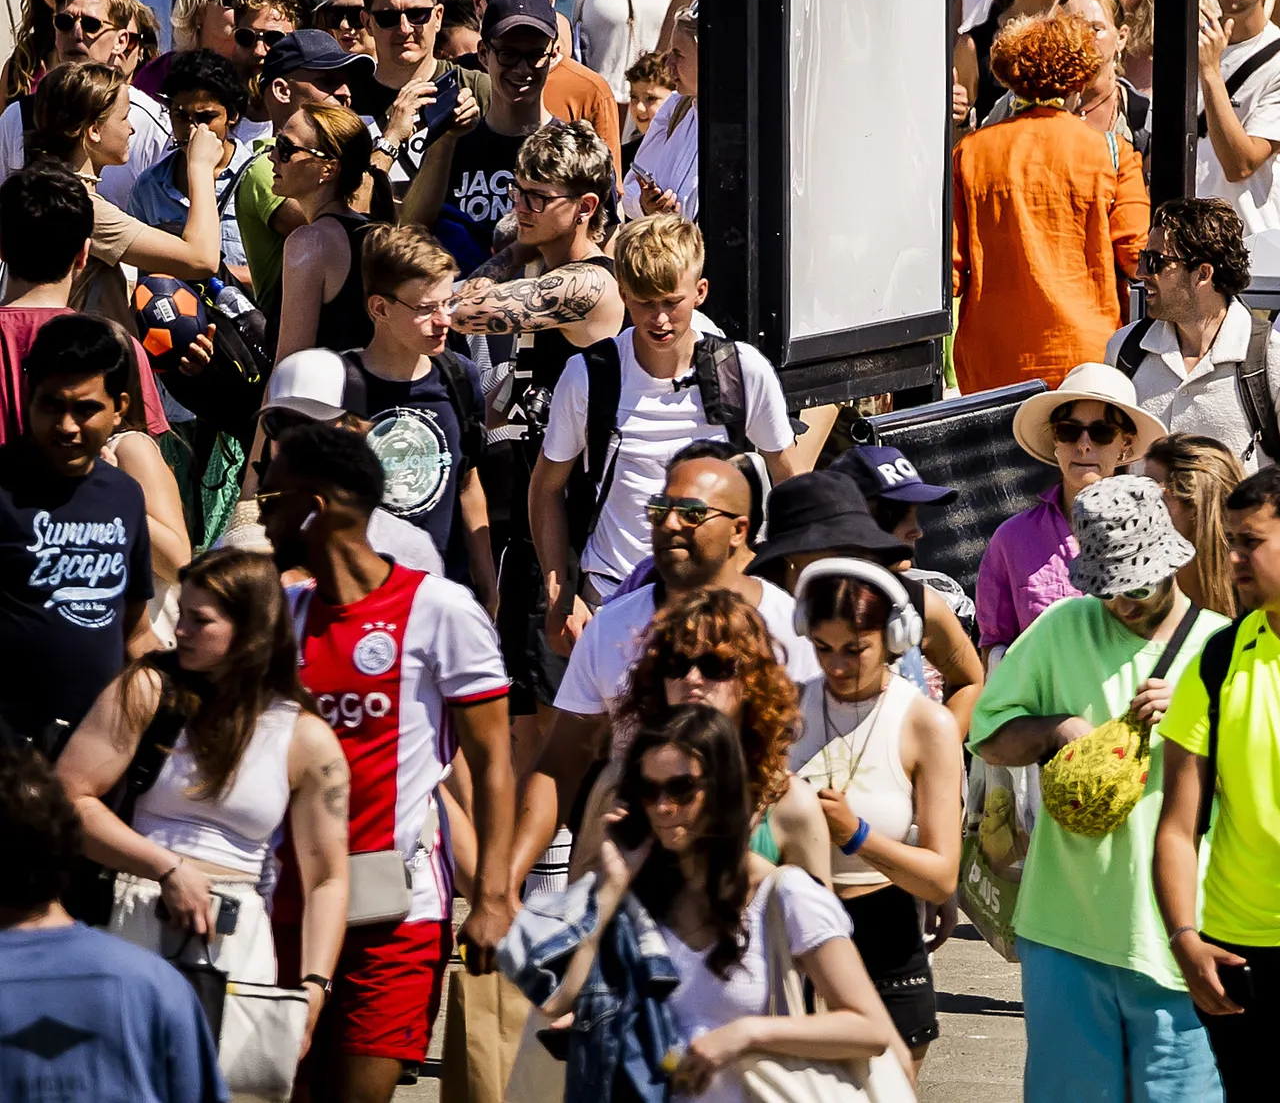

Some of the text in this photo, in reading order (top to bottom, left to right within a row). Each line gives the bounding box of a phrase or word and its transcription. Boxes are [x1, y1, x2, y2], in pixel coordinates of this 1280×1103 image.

[454, 171, 514, 197] JAC
[460, 196, 514, 222] JON
[26, 510, 128, 553] Summer
[28, 547, 127, 587] Escape
[316, 691, 392, 728] ggo
